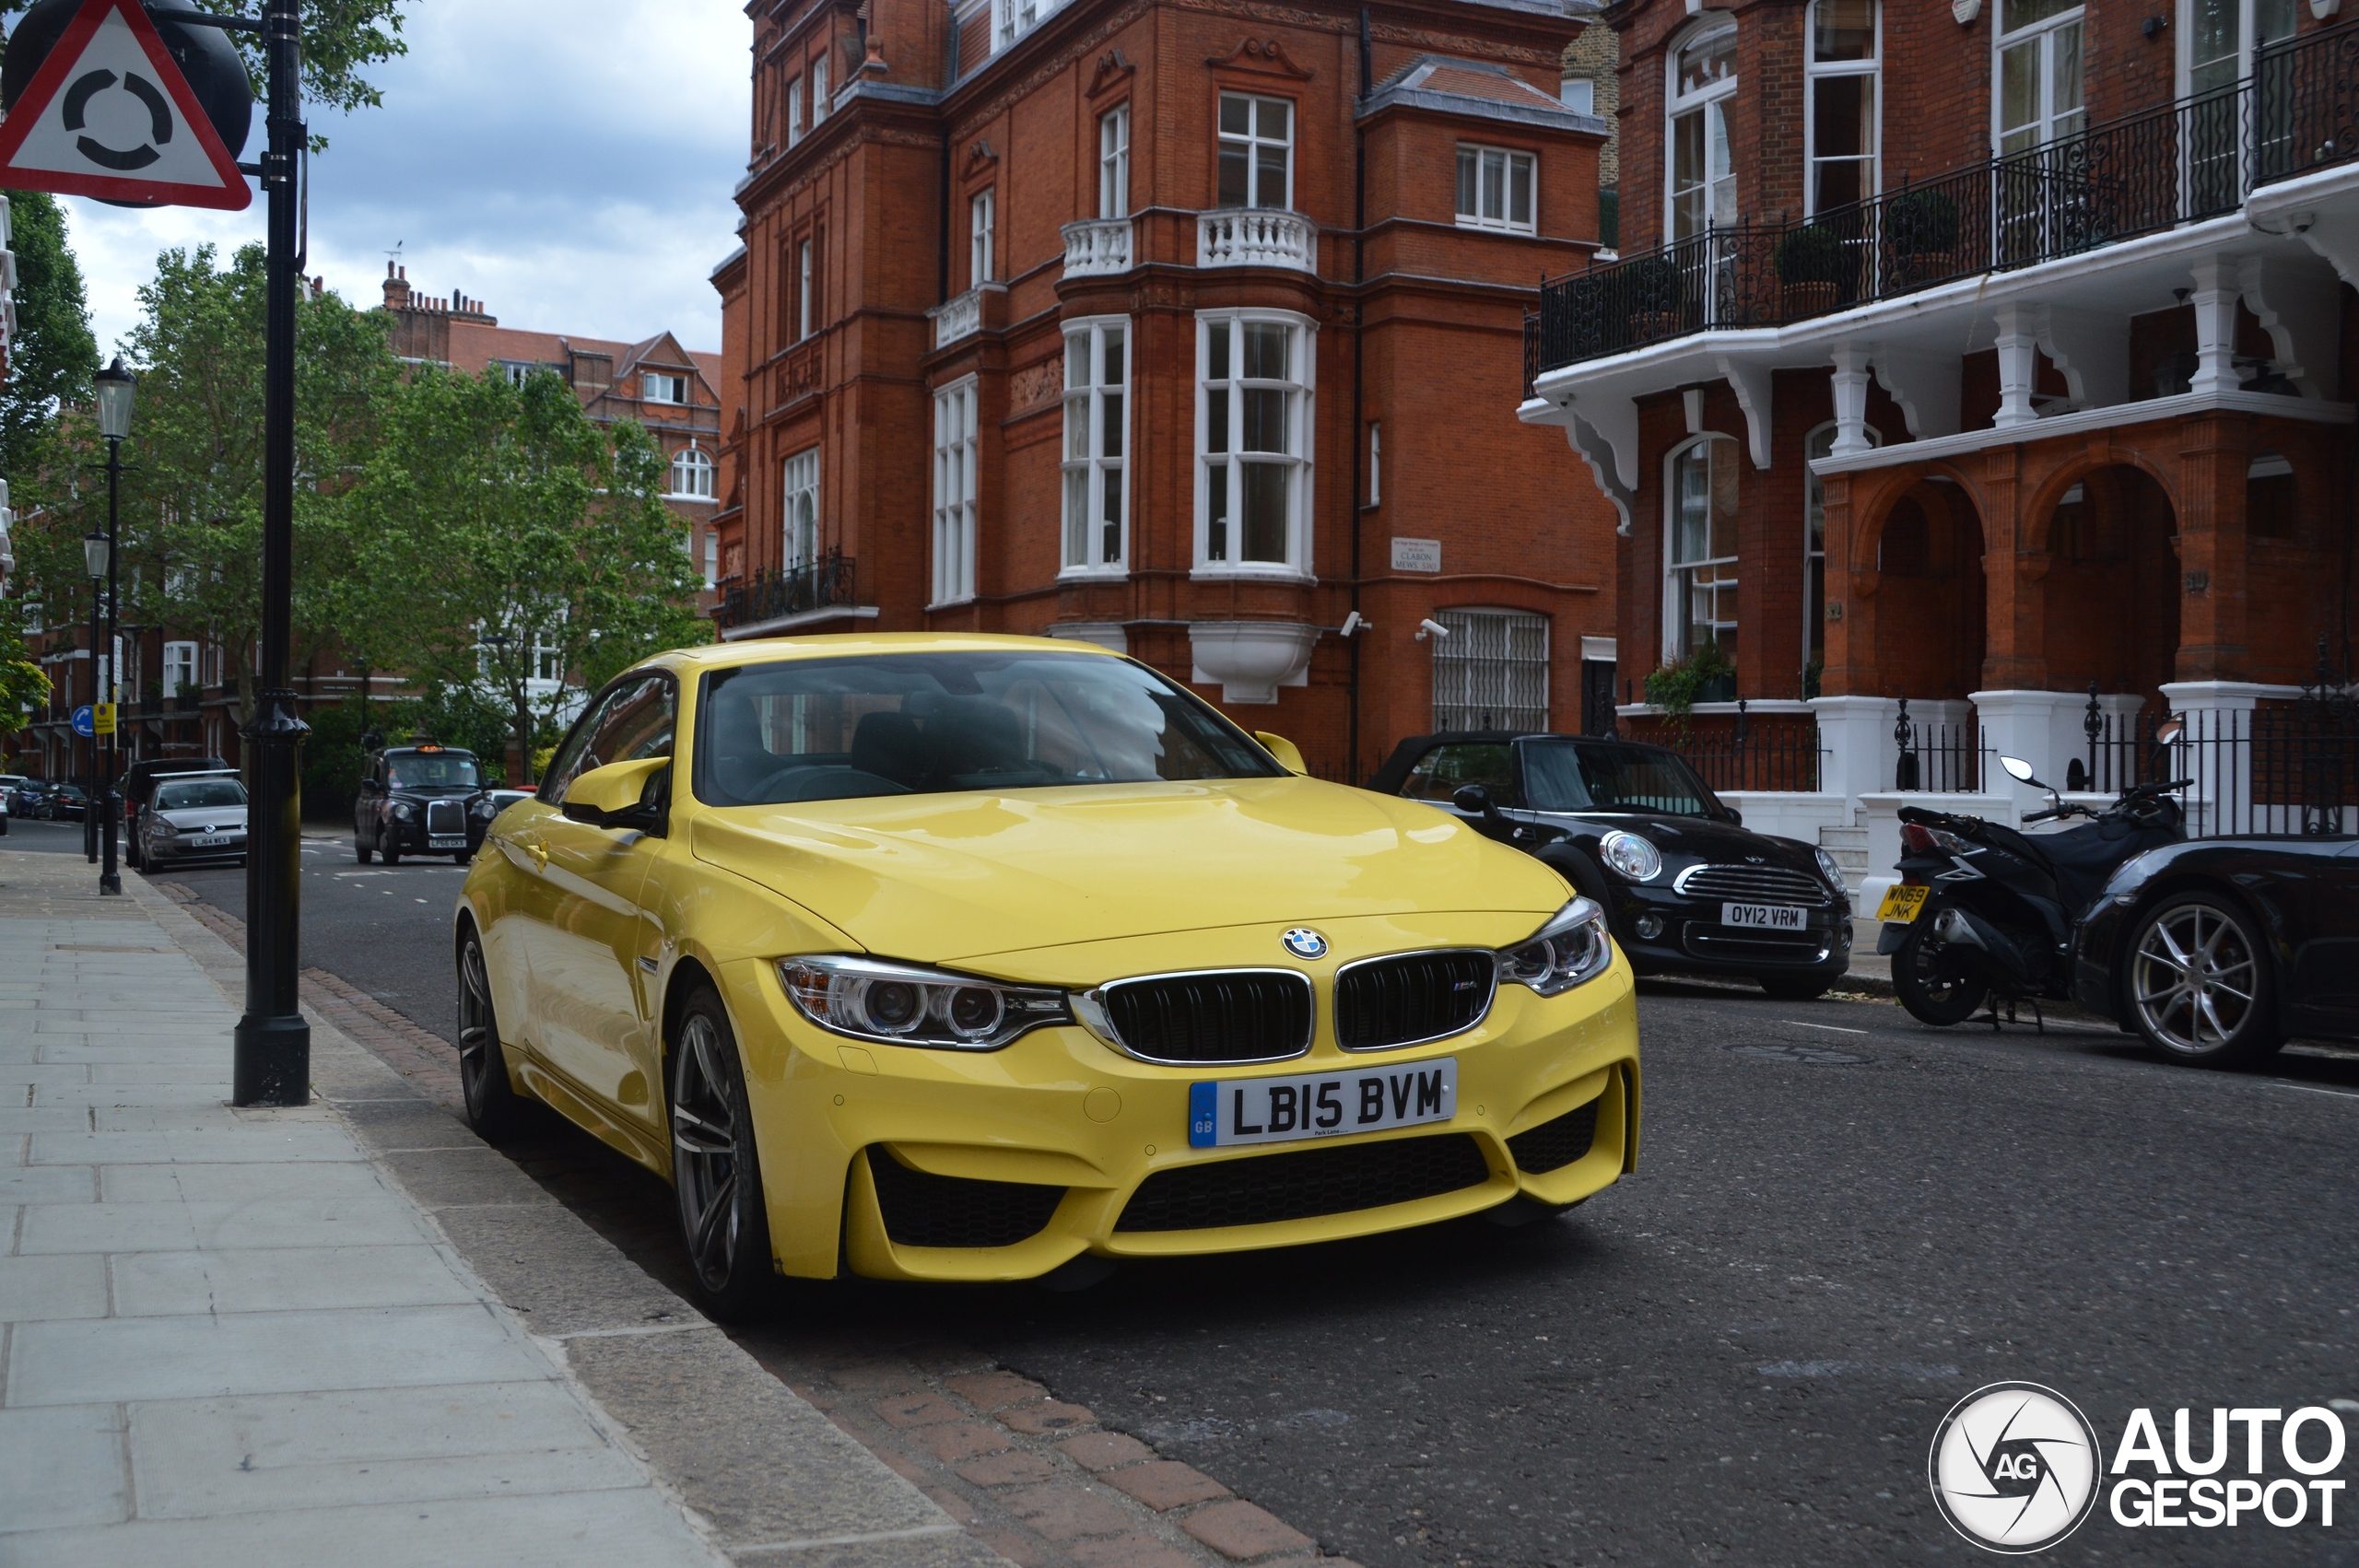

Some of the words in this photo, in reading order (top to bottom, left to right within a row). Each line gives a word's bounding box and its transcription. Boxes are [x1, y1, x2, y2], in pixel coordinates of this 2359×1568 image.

[1401, 553, 1432, 561] CLABON
[1888, 887, 1926, 903] WN69
[1732, 906, 1766, 924] OY12
[1772, 908, 1799, 927] VRM
[1884, 904, 1914, 918] JNK
[1234, 1082, 1342, 1135] LB15
[1357, 1069, 1442, 1125] BVM
[1195, 1120, 1213, 1133] GB
